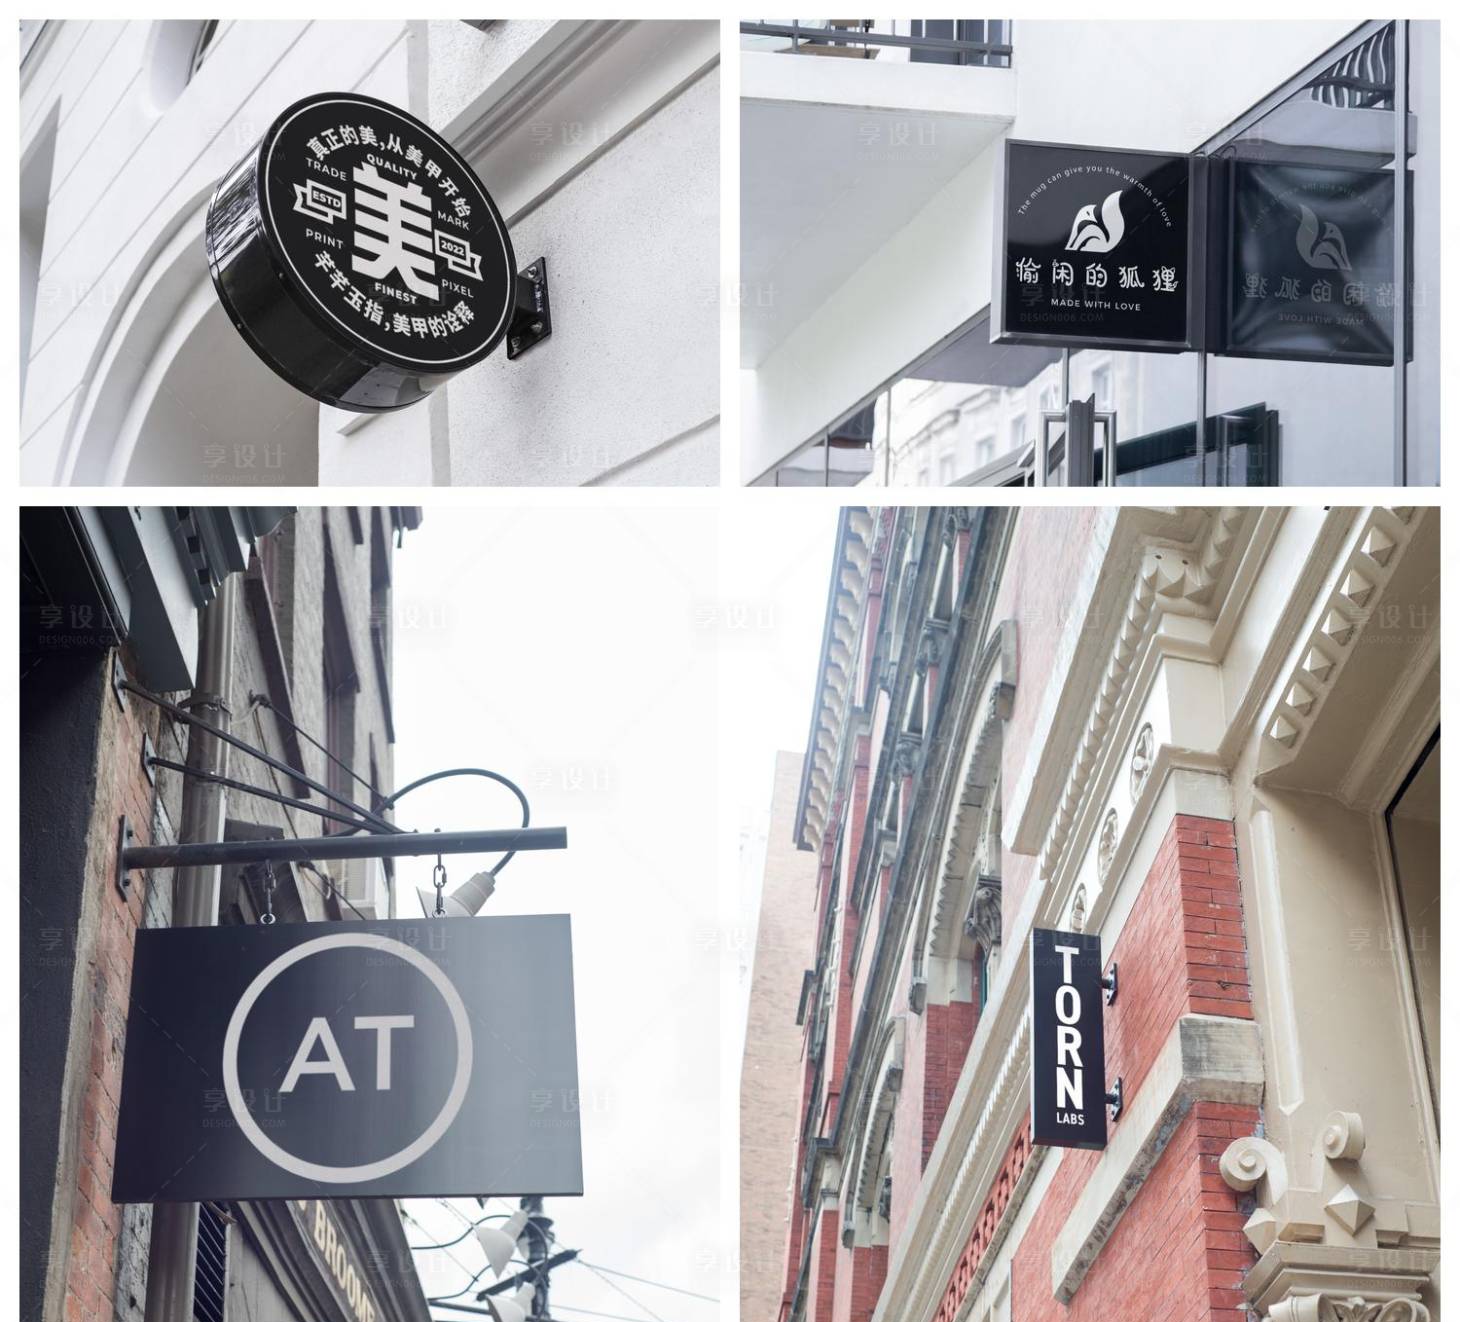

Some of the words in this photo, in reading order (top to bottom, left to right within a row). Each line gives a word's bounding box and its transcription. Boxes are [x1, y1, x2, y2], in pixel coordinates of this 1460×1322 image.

[305, 157, 347, 181] TRADE
[366, 153, 417, 180] QUALITY
[312, 189, 341, 208] ESTD
[1017, 199, 1031, 216] The
[1030, 182, 1048, 199] mug
[1047, 173, 1062, 185] can
[1064, 165, 1083, 178] give
[1086, 166, 1103, 174] you
[1106, 166, 1121, 177] the
[1123, 173, 1153, 198] warmth
[1152, 197, 1161, 208] of
[1160, 207, 1172, 228] love
[352, 161, 440, 301] 美
[437, 210, 470, 231] MARK
[305, 228, 344, 250] PRINT
[441, 240, 464, 257] 2022
[374, 282, 417, 304] FINEST
[441, 279, 474, 298] PIXEL
[1051, 298, 1081, 308] MADE
[1084, 300, 1111, 310] WITH
[1115, 301, 1141, 312] LOVE
[1055, 945, 1084, 1111] TORN
[279, 1015, 415, 1093] AT
[1056, 1112, 1085, 1126] LABS
